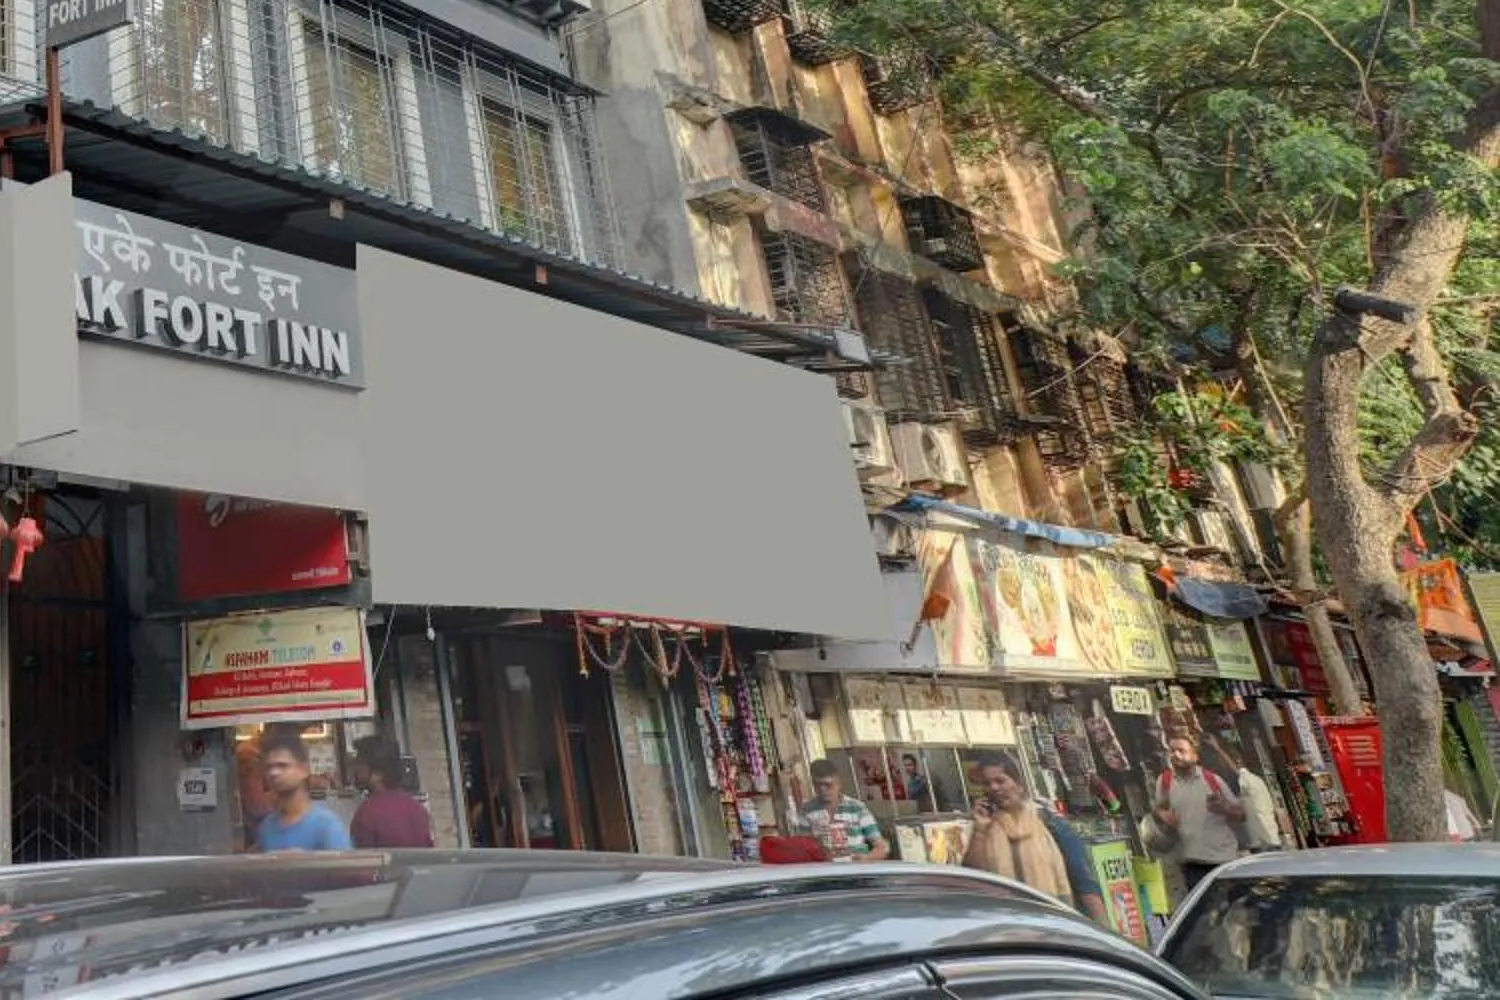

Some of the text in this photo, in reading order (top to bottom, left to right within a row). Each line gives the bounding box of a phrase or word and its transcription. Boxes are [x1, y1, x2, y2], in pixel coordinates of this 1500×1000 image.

[76, 214, 302, 311] एके फोर्ट इन
[141, 287, 261, 356] FORT
[276, 318, 350, 374] INN
